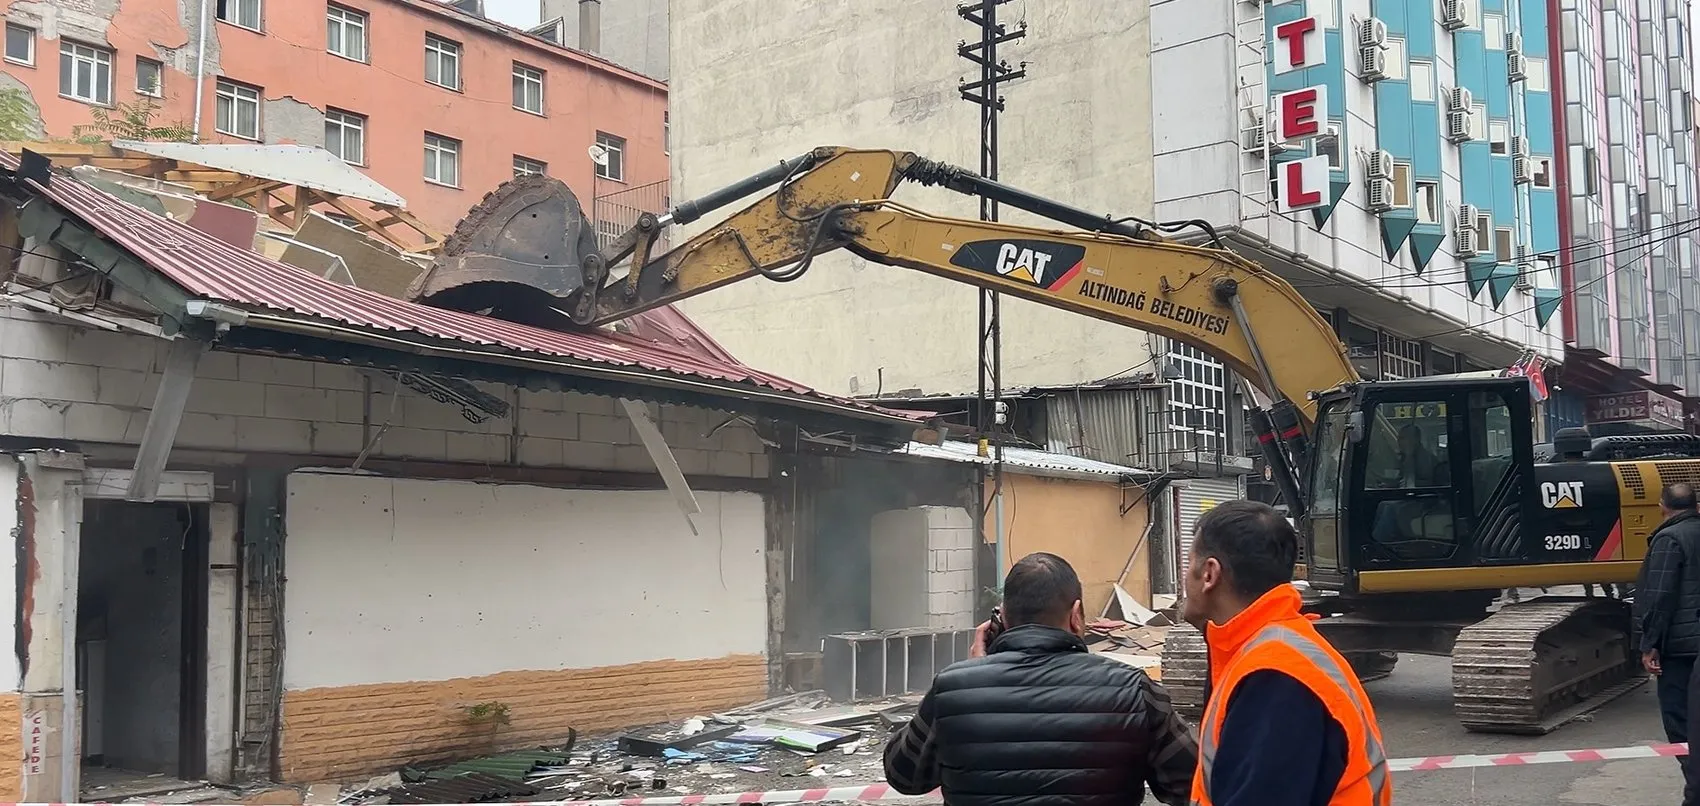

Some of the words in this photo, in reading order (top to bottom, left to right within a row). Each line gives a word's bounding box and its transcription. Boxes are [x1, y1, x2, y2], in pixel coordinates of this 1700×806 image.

[1277, 17, 1322, 208] TEL
[996, 243, 1052, 284] CAT
[1078, 279, 1146, 311] ALTINDAĞ
[1150, 296, 1230, 336] BELEDİYESİ
[1592, 406, 1647, 420] YILDIZ
[1599, 395, 1643, 406] HOTEL
[1540, 481, 1585, 509] CAT
[1544, 535, 1581, 550] 329D
[31, 717, 41, 773] CAFEDE
